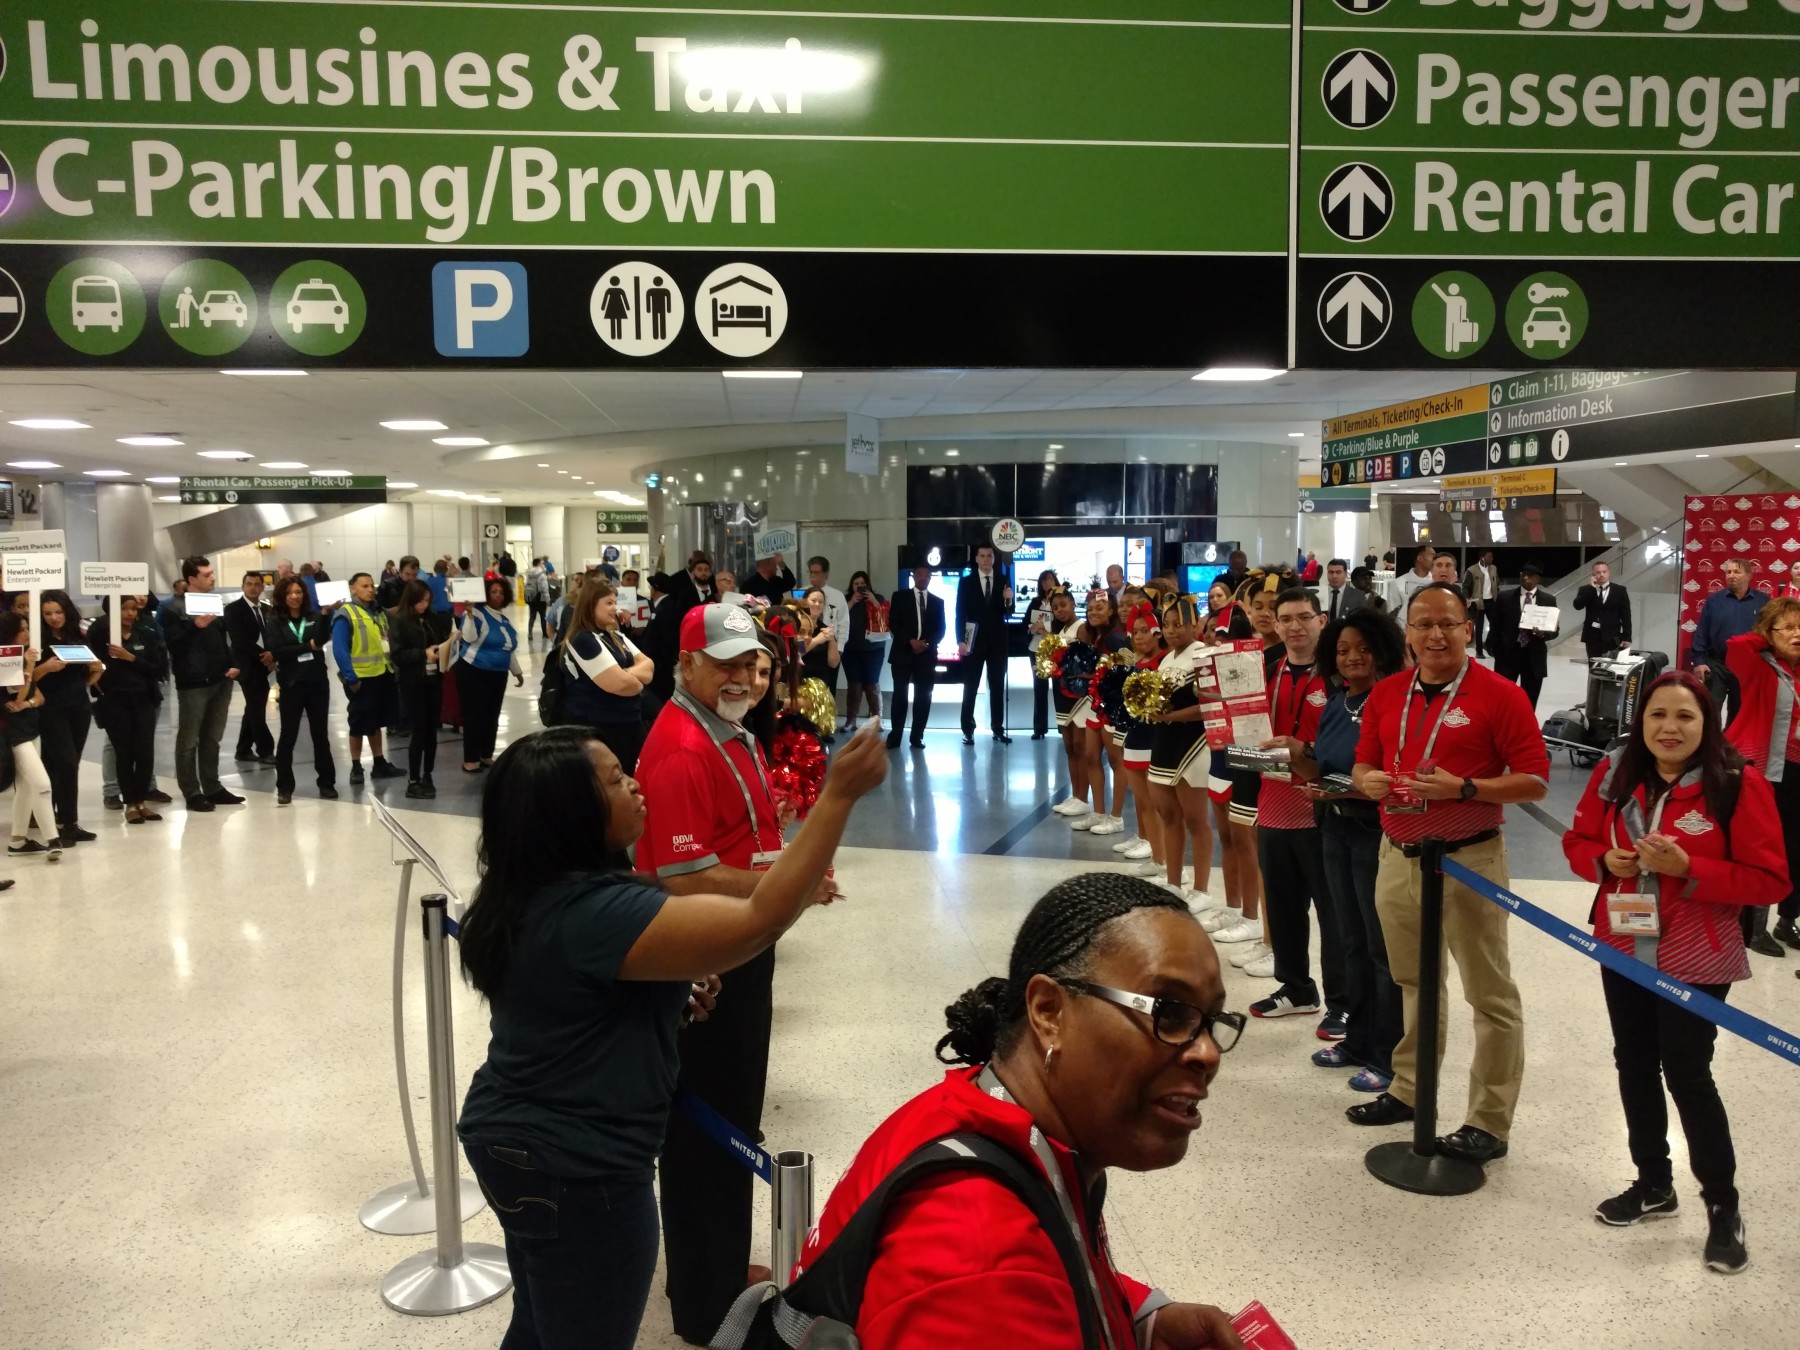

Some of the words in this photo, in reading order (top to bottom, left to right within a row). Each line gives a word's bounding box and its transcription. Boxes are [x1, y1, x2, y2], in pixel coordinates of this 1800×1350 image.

[28, 18, 534, 110] Limousines
[558, 34, 620, 111] &
[1416, 53, 1799, 149] Passenger
[36, 138, 776, 242] C-Parking/Brown
[1414, 160, 1650, 233] Rental
[1672, 164, 1794, 234] Car
[454, 269, 513, 349] P
[1508, 381, 1539, 400] Claim
[1543, 373, 1568, 392] 1-11,
[1332, 422, 1342, 435] All
[1344, 415, 1380, 432] Terminals,
[1382, 396, 1463, 424] Ticketing/Check-In
[1507, 404, 1577, 429] Information
[1581, 394, 1613, 418] Desk
[1332, 437, 1384, 457] C-Parking/Blue
[1385, 434, 1391, 448] &
[1392, 429, 1420, 450] Purple
[1348, 463, 1355, 477] A
[1366, 459, 1373, 476] C
[1375, 458, 1382, 475] D
[1384, 457, 1391, 473] E
[1402, 457, 1409, 473] P
[193, 477, 229, 487] Rental
[230, 478, 252, 488] Car,
[254, 478, 309, 488] Passenger
[312, 476, 353, 488] Pick-Up
[35, 567, 62, 575] Packard
[672, 834, 693, 844] BBVA
[1496, 892, 1514, 906] UNITED
[1568, 932, 1590, 949] UNITED
[1656, 979, 1682, 997] UNITED
[1767, 1034, 1800, 1054] UNITED
[730, 1136, 756, 1161] UNITED
